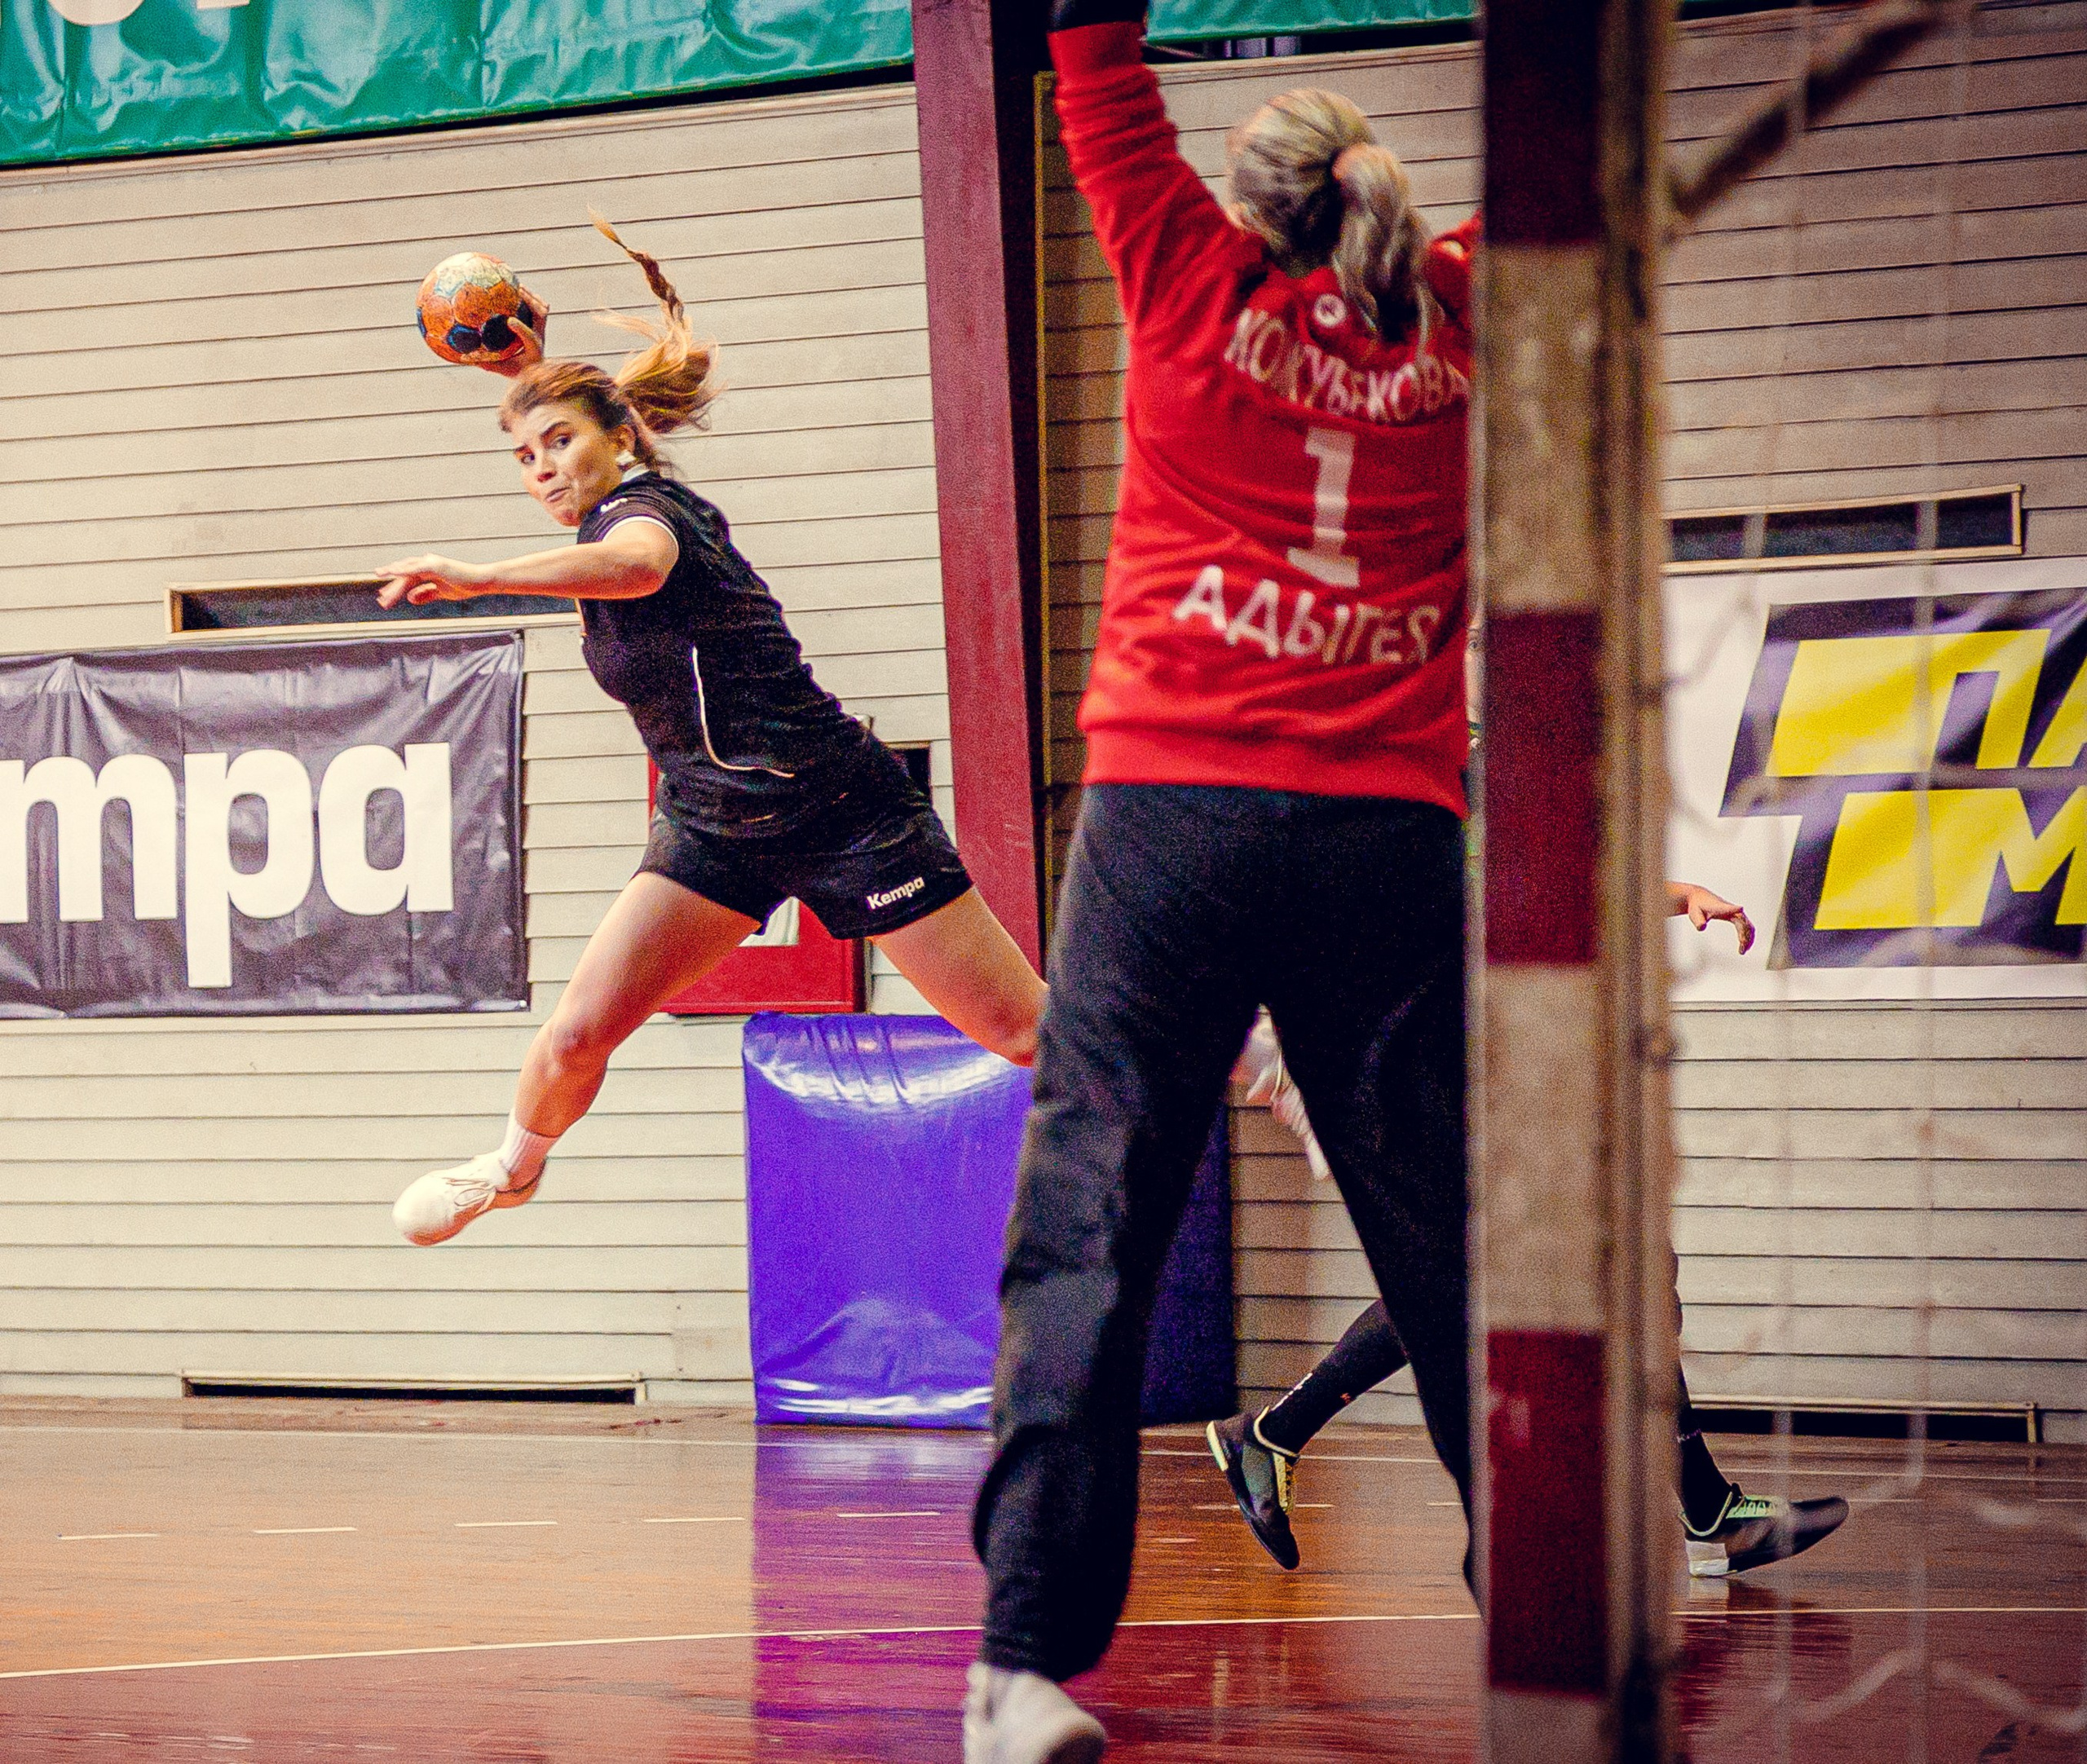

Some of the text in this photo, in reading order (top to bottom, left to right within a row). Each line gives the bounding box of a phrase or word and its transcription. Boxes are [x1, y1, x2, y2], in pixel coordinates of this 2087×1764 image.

[1286, 426, 1361, 588] 1
[0, 742, 454, 988] mpa
[867, 876, 925, 910] Kempa
